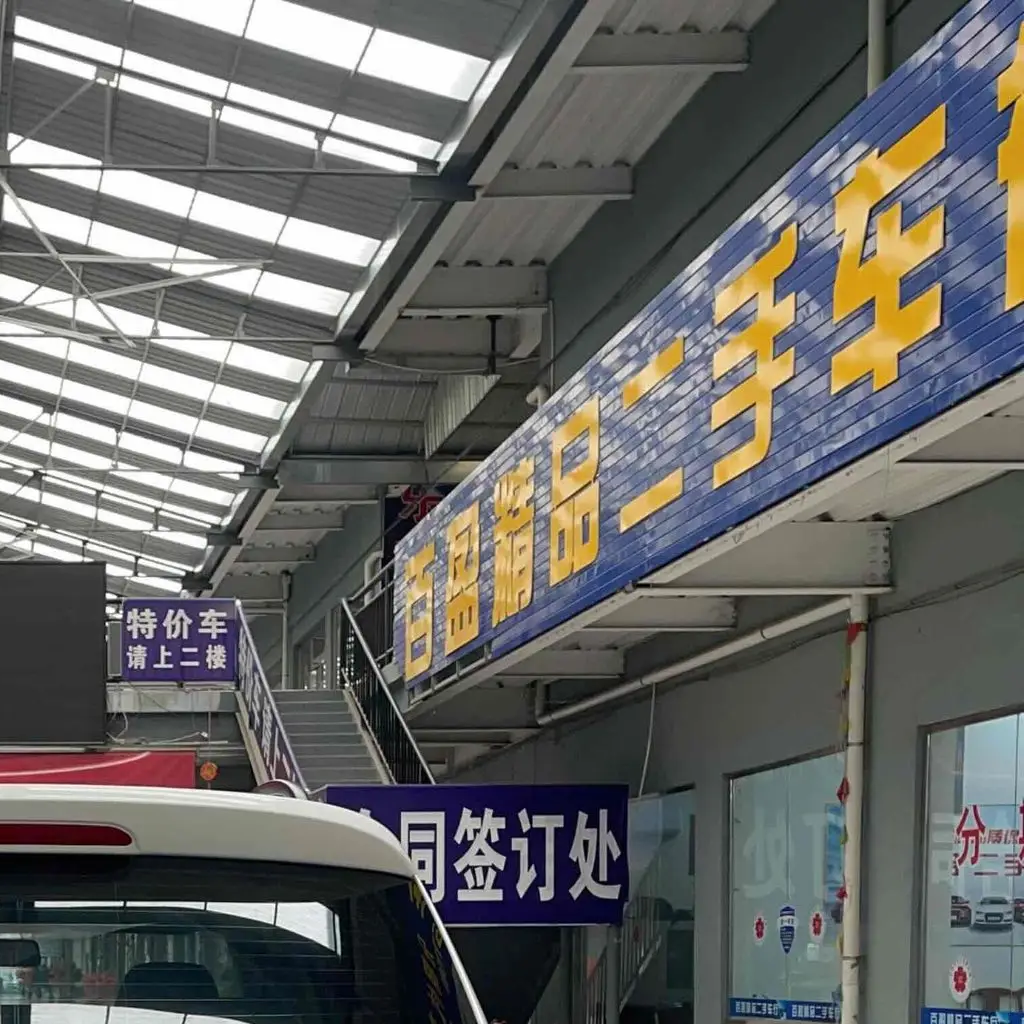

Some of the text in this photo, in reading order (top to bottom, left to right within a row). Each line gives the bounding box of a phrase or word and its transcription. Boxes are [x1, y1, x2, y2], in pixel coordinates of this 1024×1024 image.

[404, 22, 1024, 680] 百盈精品二手车
[127, 608, 228, 639] 特价车
[127, 645, 227, 670] 请上二楼
[359, 807, 622, 902] 同签订处
